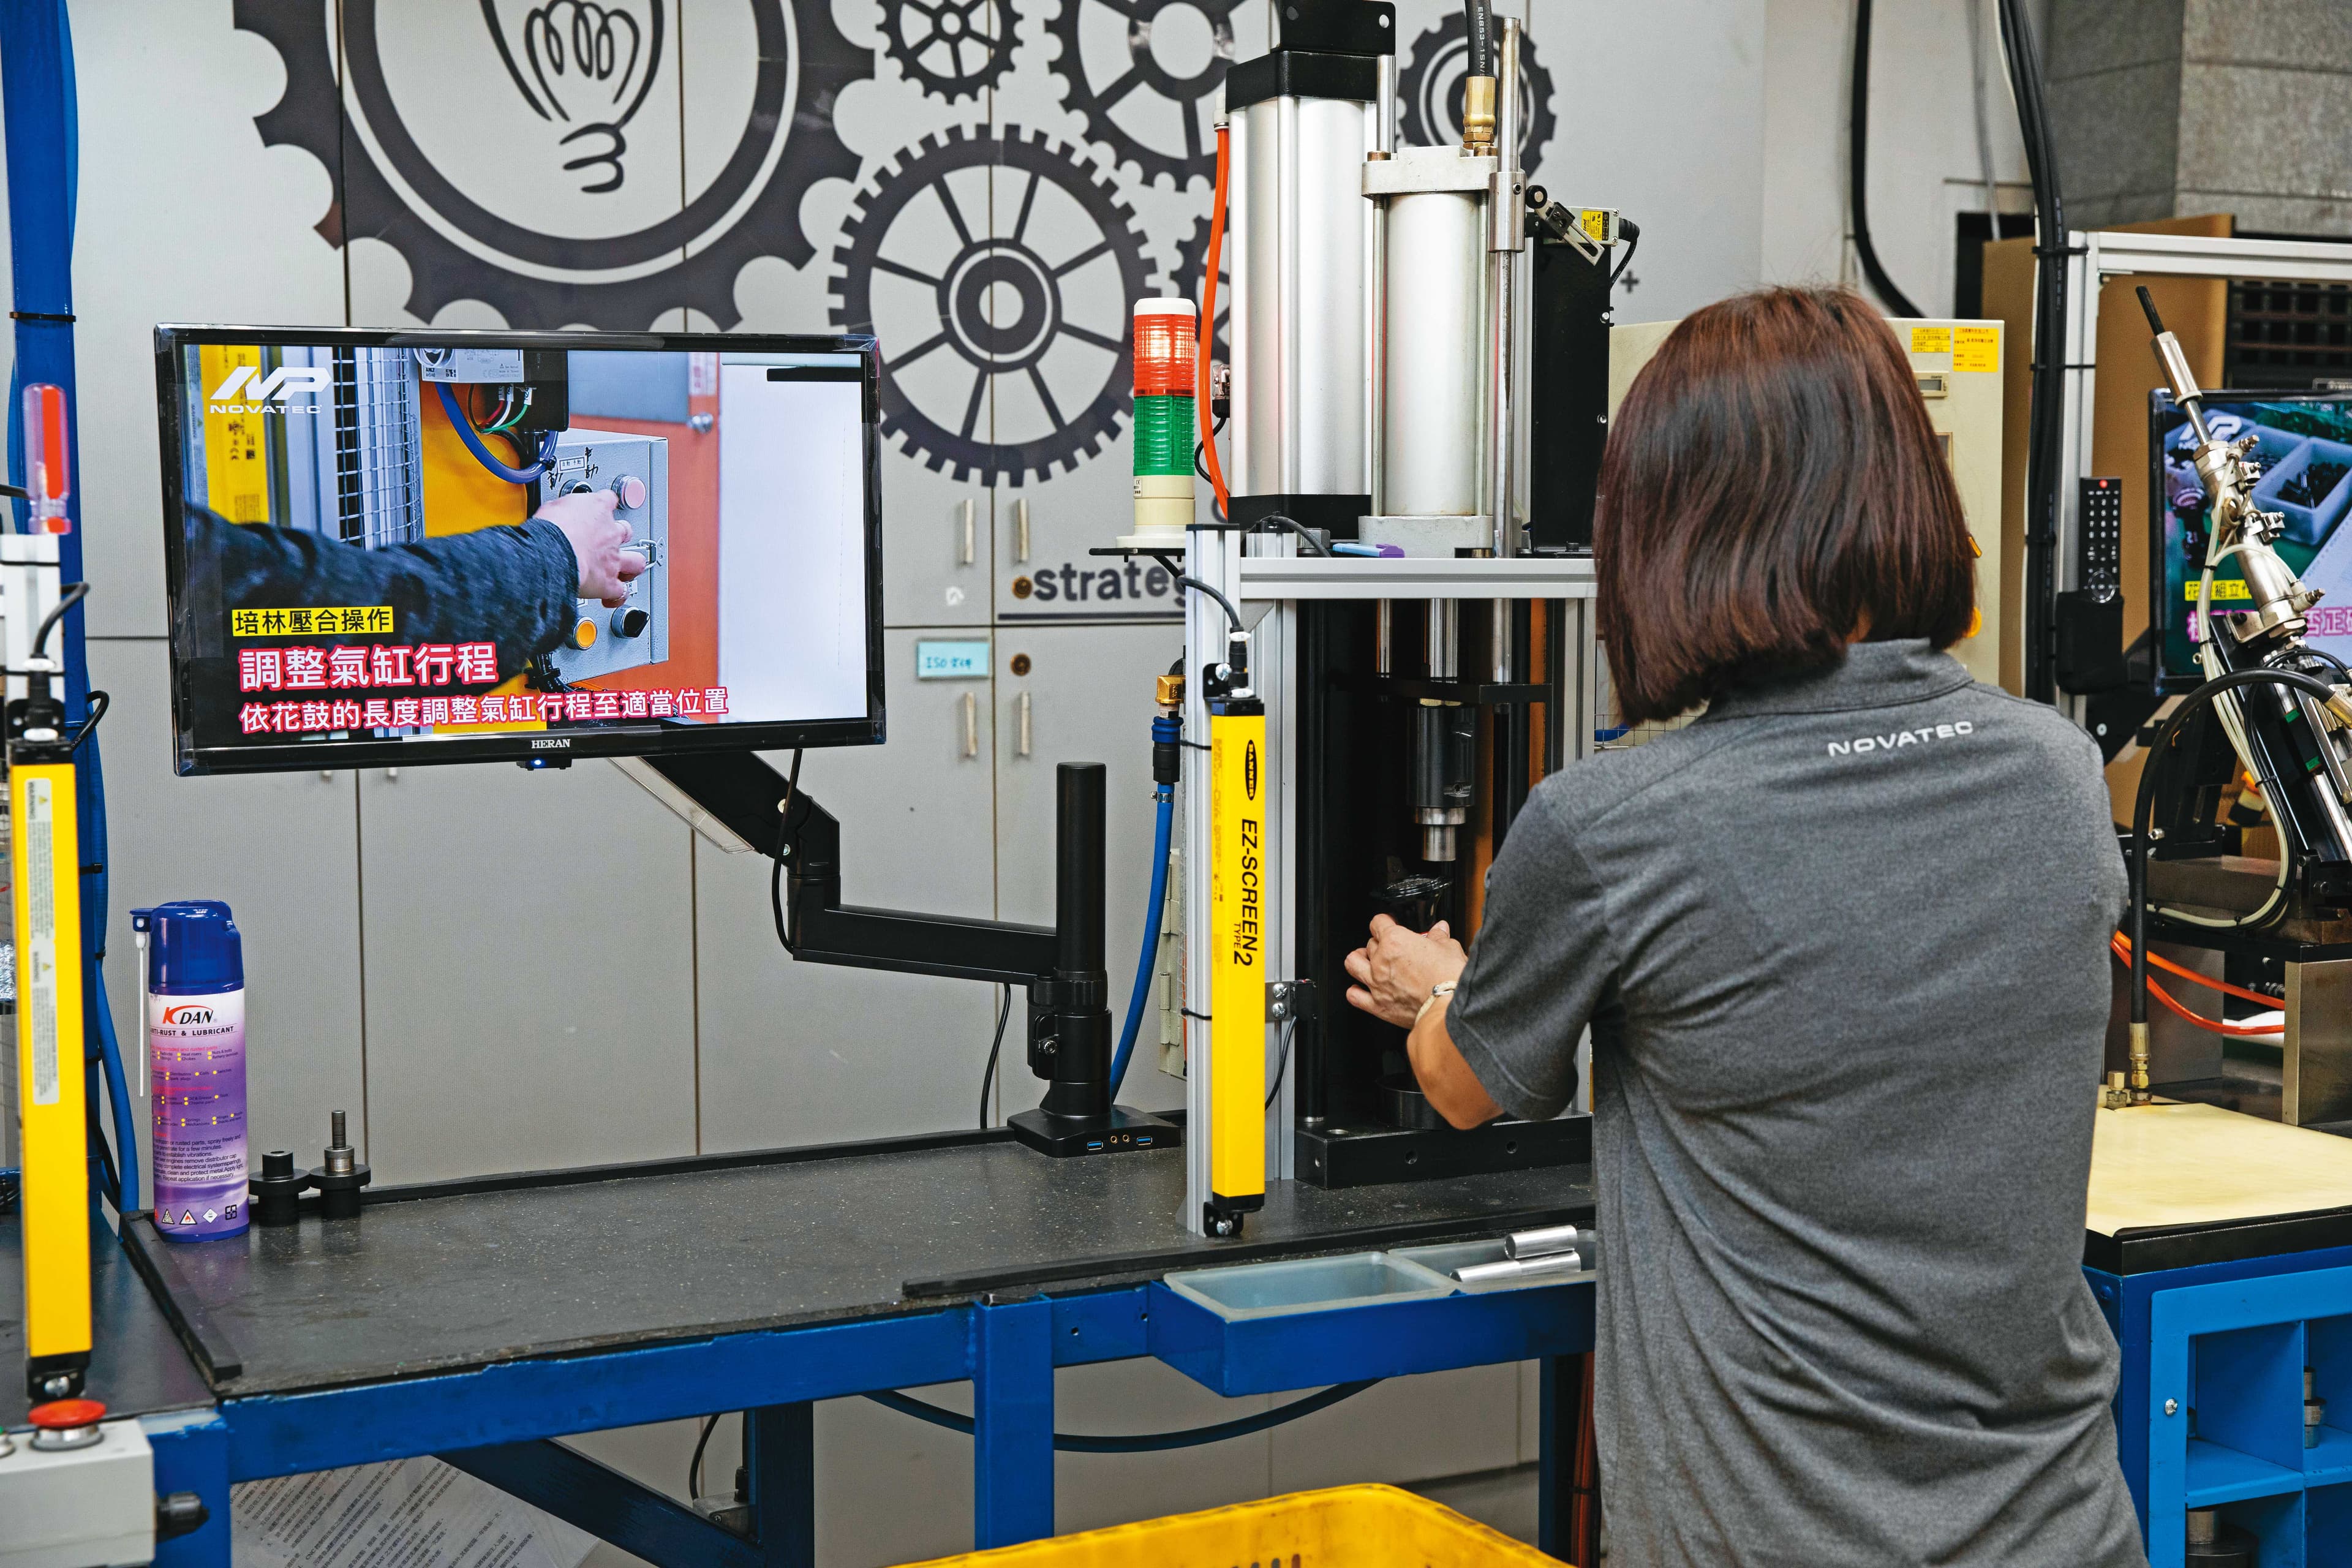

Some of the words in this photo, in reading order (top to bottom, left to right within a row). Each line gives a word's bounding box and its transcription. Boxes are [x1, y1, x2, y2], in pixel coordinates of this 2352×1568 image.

[210, 404, 321, 414] NOVATEC
[235, 608, 390, 635] 培林壓合操作
[239, 644, 497, 690] 調整氣缸行程
[239, 686, 728, 732] 依花鼓的長度調整氣缸行程至適當位置
[531, 738, 571, 748] HERAN
[1828, 721, 1973, 757] NOVATEC
[1242, 819, 1257, 951] EZ-SCREEN
[1234, 951, 1253, 967] 2
[162, 1005, 214, 1024] KDAN
[192, 1026, 234, 1036] LUBRICANT
